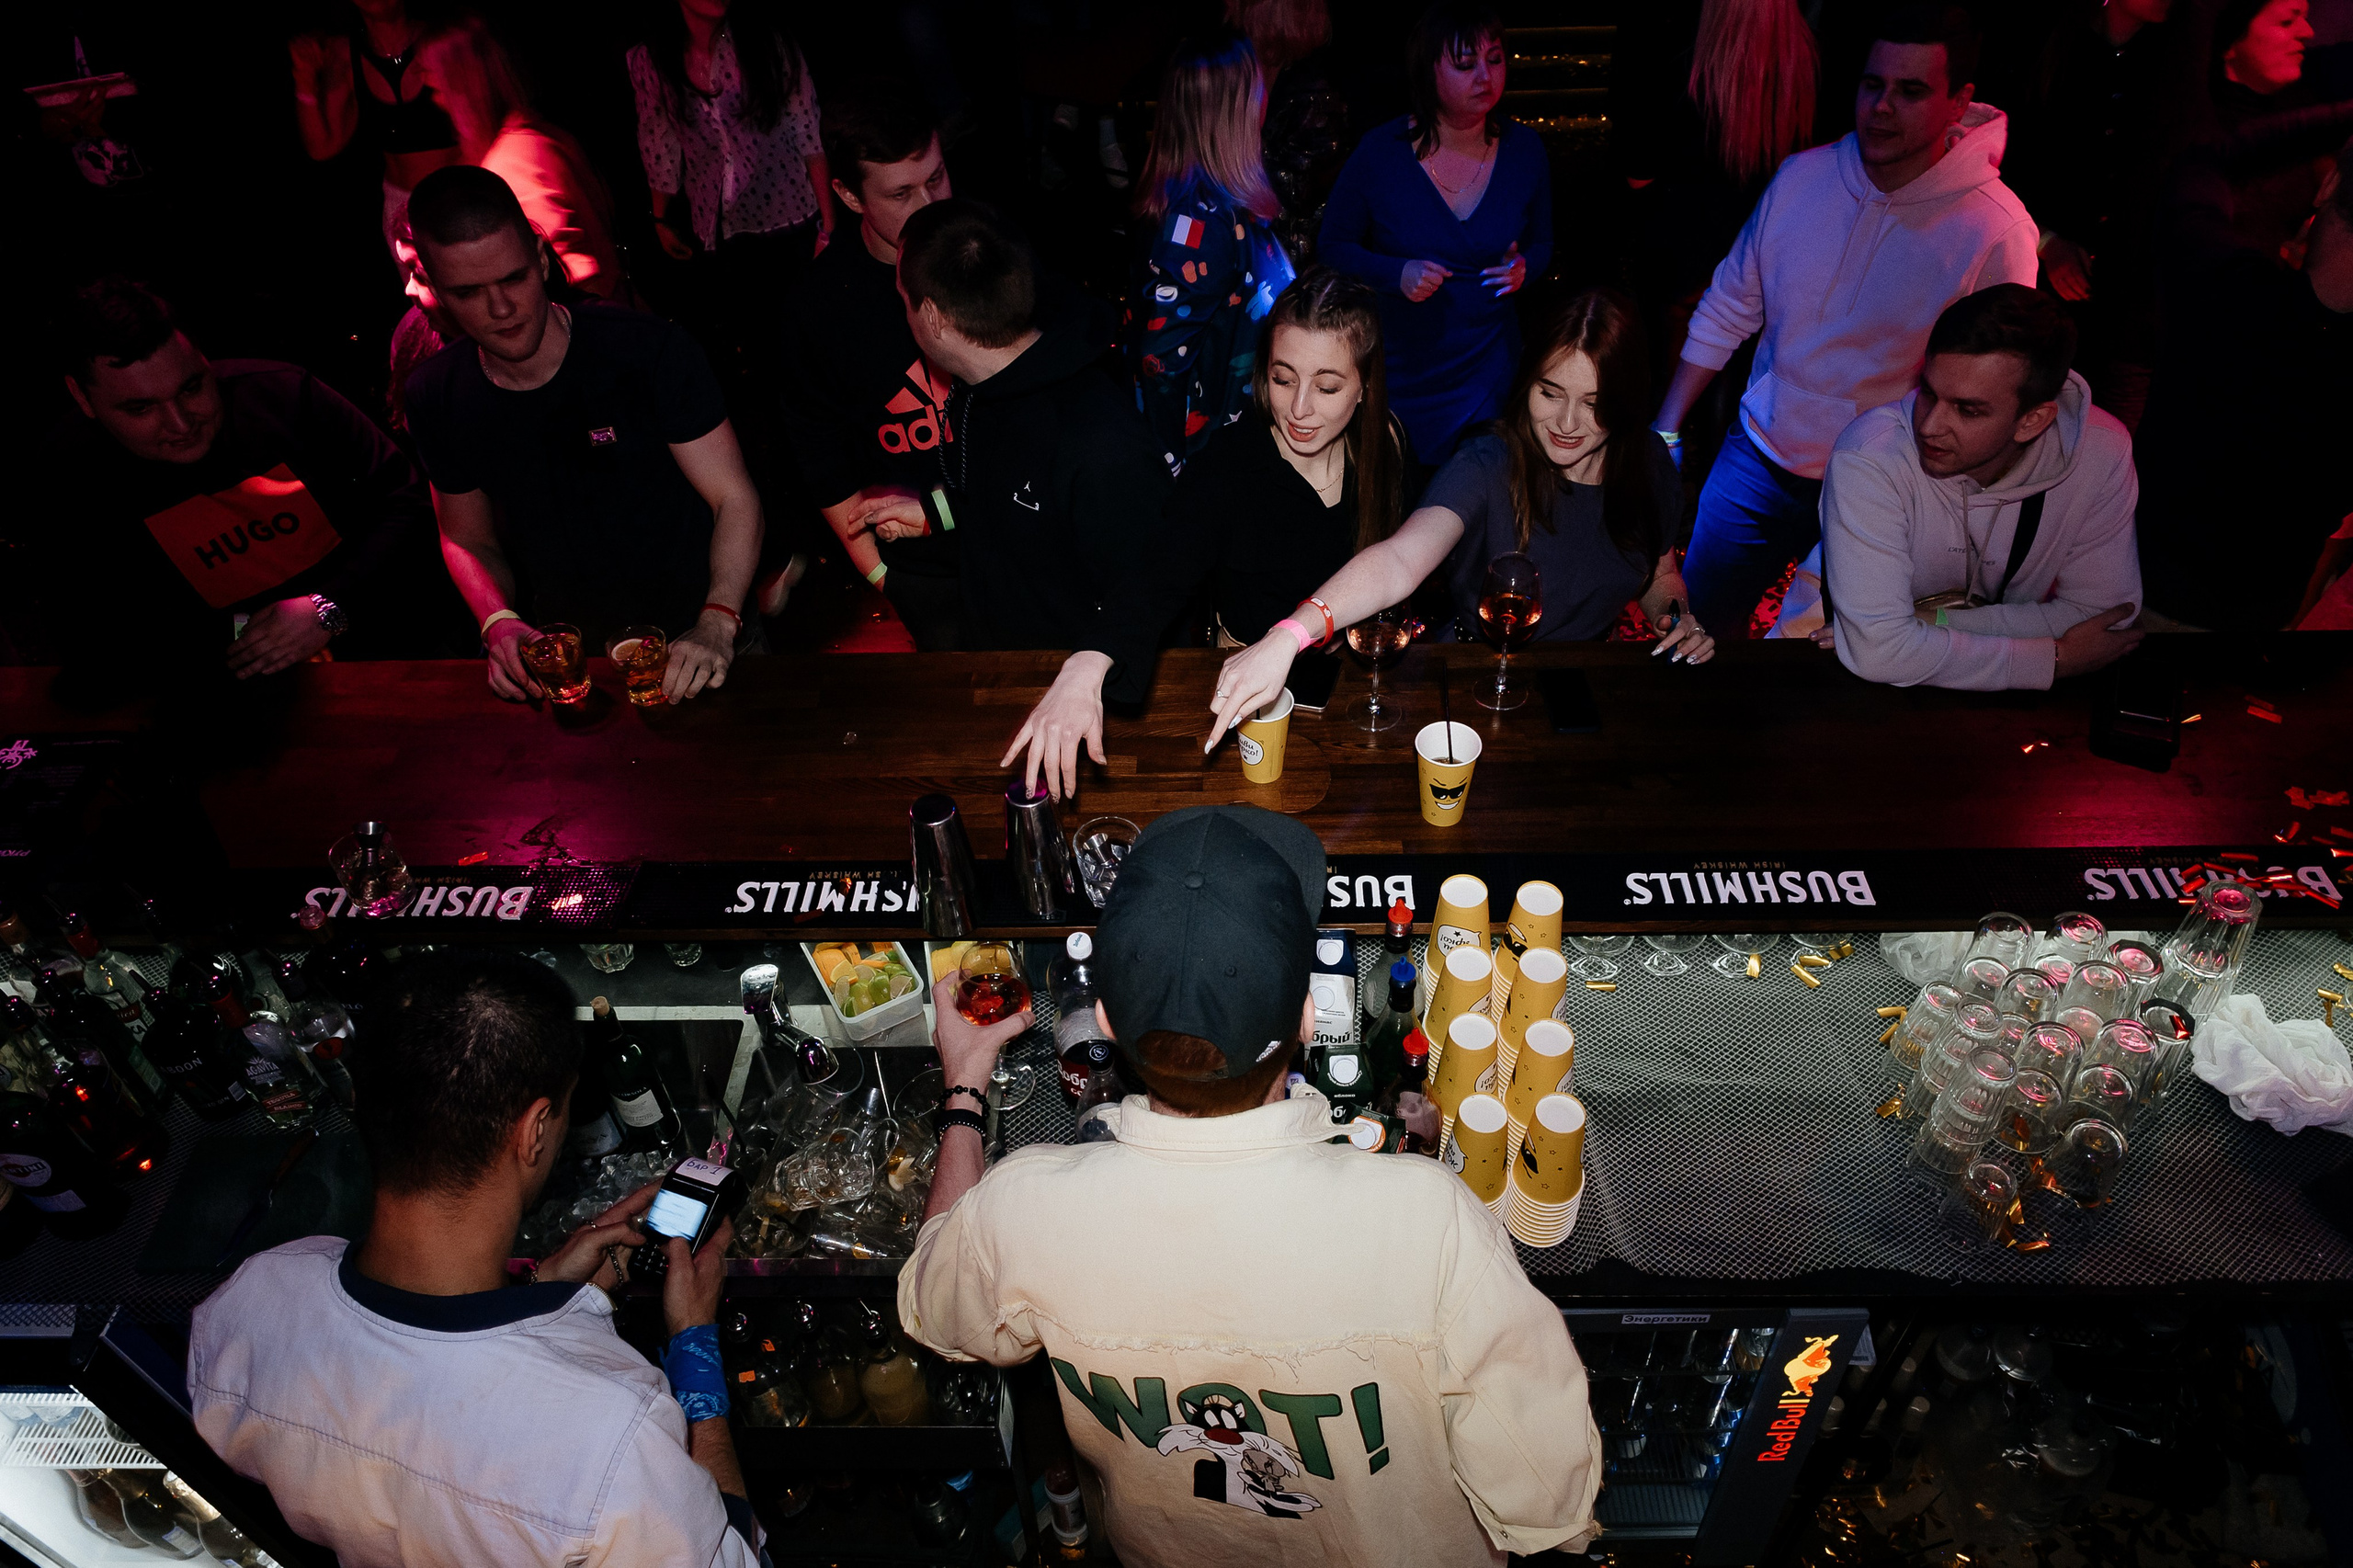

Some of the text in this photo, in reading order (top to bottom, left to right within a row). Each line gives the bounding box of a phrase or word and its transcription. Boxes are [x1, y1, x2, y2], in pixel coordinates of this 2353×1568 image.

[878, 404, 954, 454] adi
[193, 512, 300, 570] HUGO
[1694, 861, 1787, 869] IRISH WHISKEY
[733, 881, 920, 913] USHMILLS
[1326, 874, 1416, 910] BUS
[1624, 869, 1877, 906] BUSHMILLS
[2084, 865, 2344, 901] BILLS
[305, 885, 535, 920] BUSHLS
[1312, 1030, 1351, 1045] брый
[245, 1061, 280, 1077] AGAVITA
[267, 1091, 297, 1106] TEQUILA
[1623, 1314, 1709, 1324] Энергетики
[1050, 1357, 1391, 1481] WOT!
